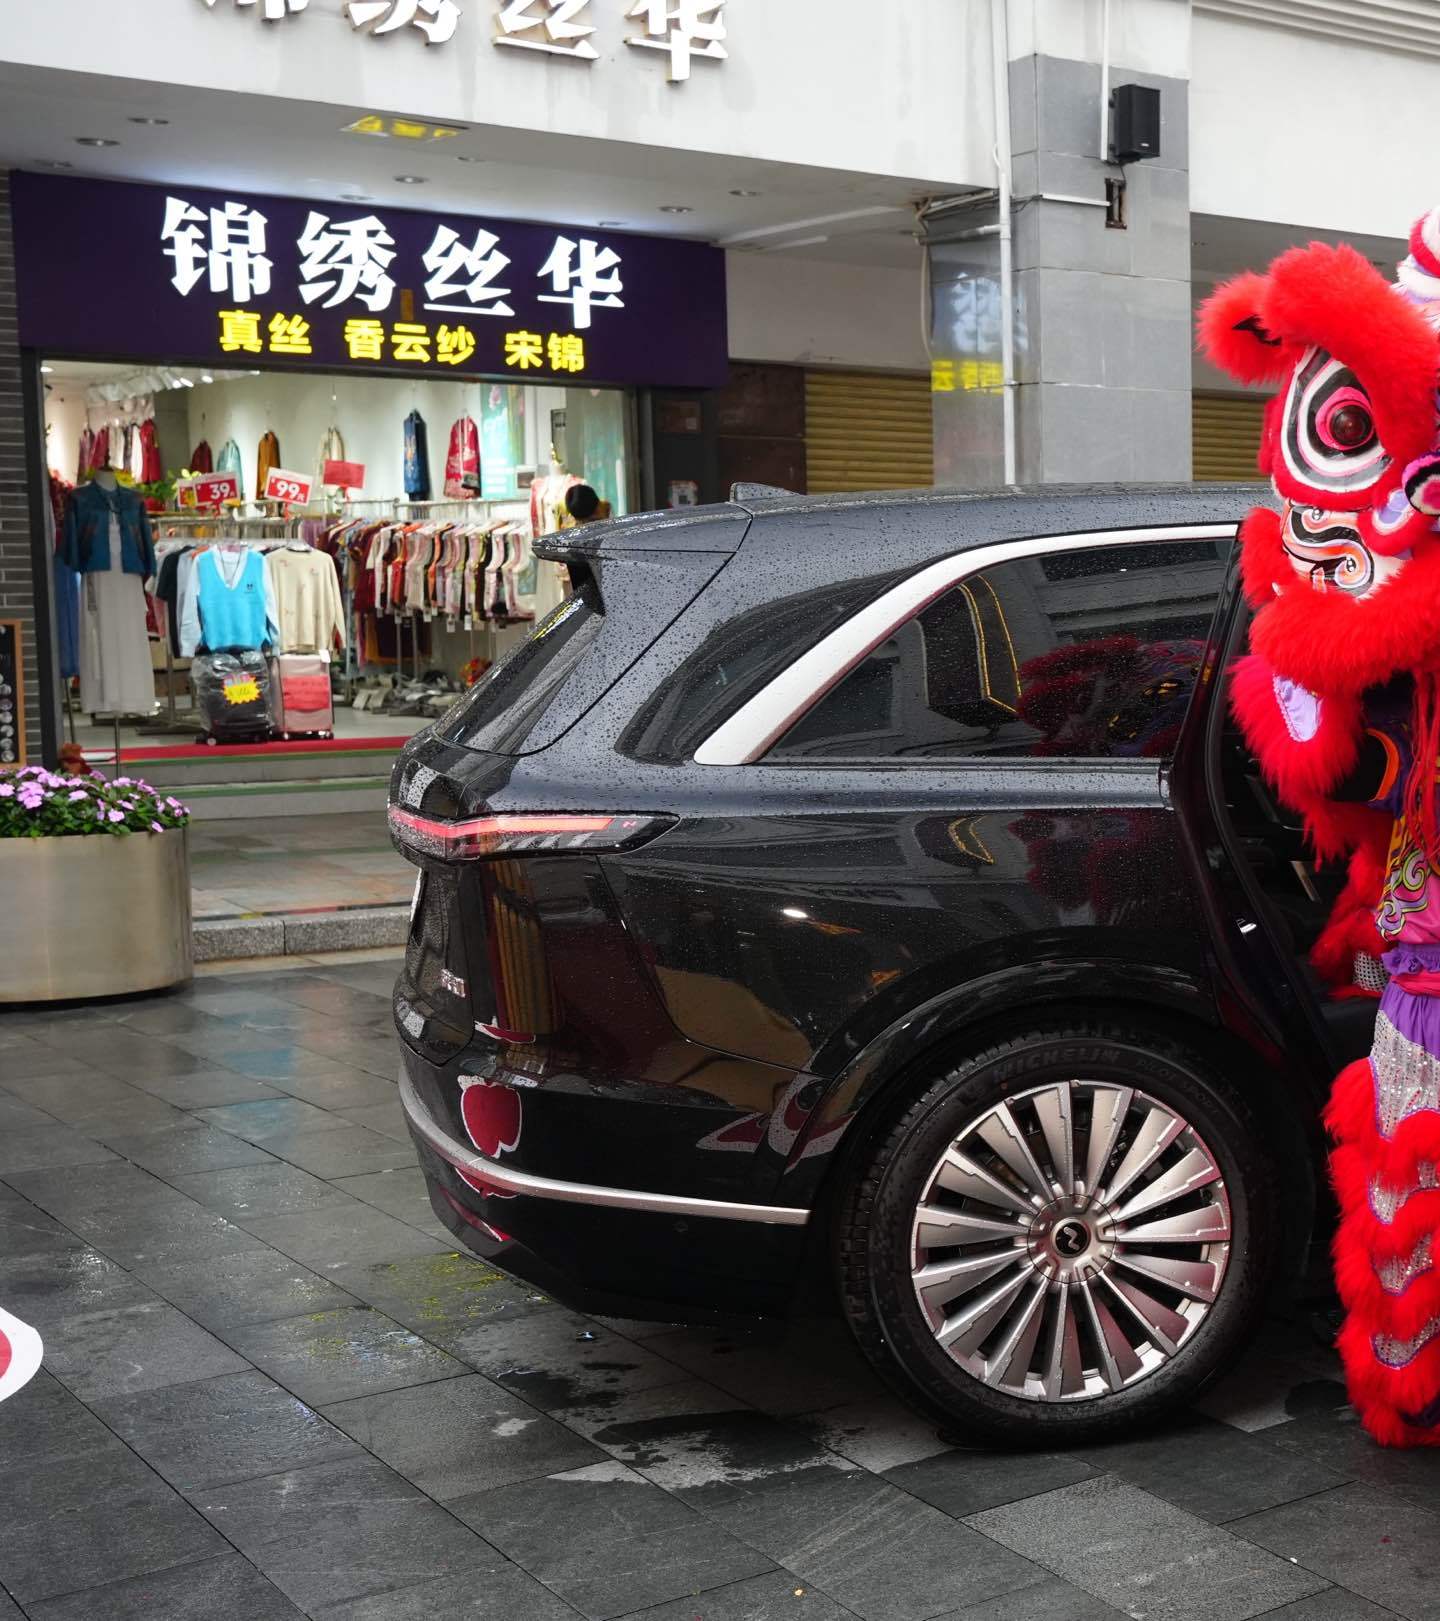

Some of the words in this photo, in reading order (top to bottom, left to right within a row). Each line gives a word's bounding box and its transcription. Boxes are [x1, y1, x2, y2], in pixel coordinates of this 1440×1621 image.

[160, 196, 625, 329] 锦绣丝华
[217, 308, 313, 355] 真丝
[343, 318, 476, 366] 香云纱
[503, 330, 586, 373] 宋锦
[209, 482, 231, 500] 39
[276, 481, 301, 498] 99
